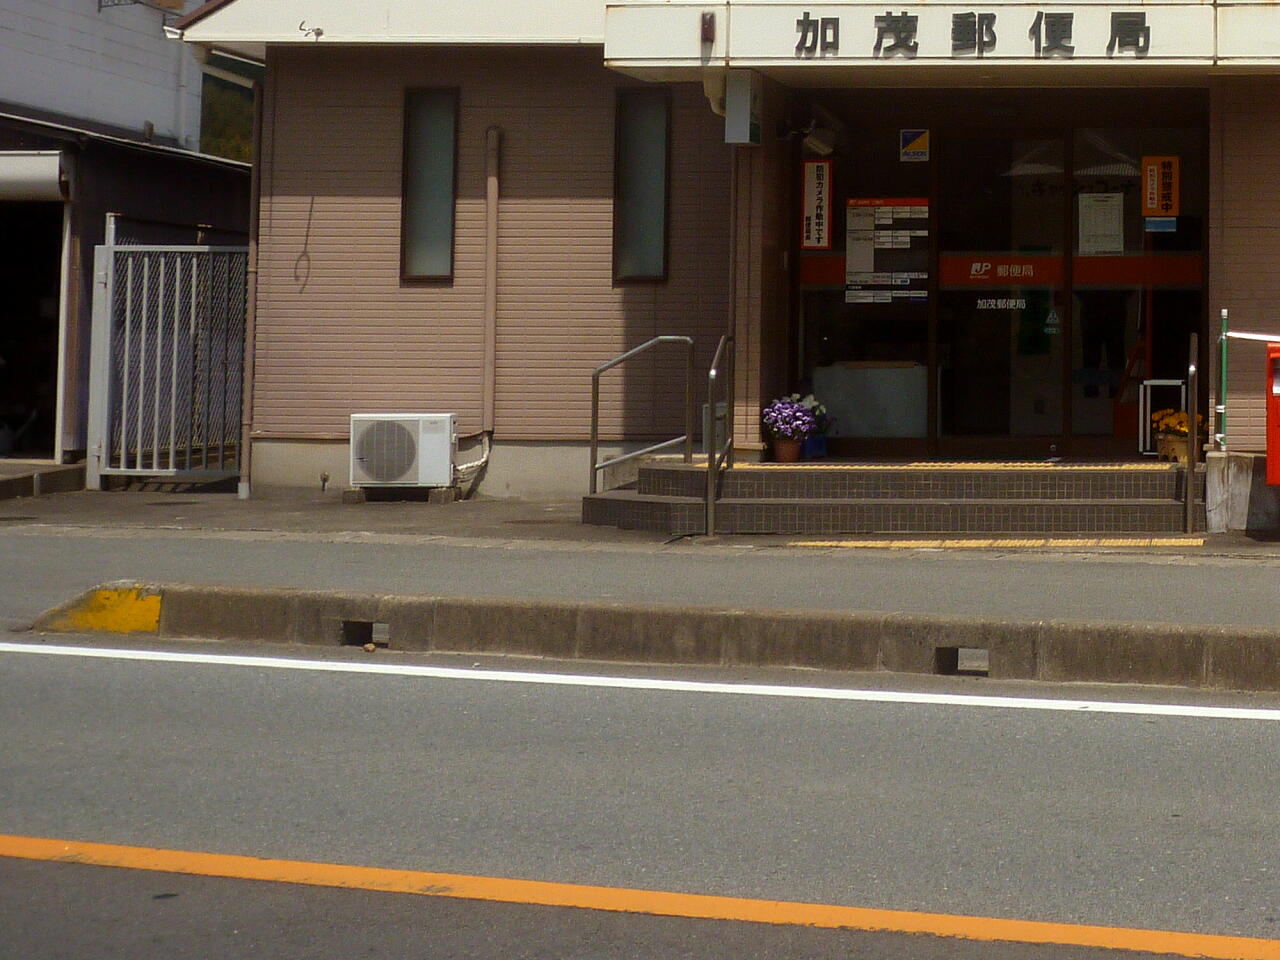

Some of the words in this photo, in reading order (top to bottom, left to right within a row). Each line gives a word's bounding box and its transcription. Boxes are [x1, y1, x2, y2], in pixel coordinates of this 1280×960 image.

[795, 11, 1151, 55] 加茂郵便局
[816, 165, 825, 245] 防犯カメラ作動中です
[1161, 160, 1173, 212] 特別警戒中
[997, 264, 1034, 277] 郵便局
[976, 298, 1026, 310] 加茂郵便局
